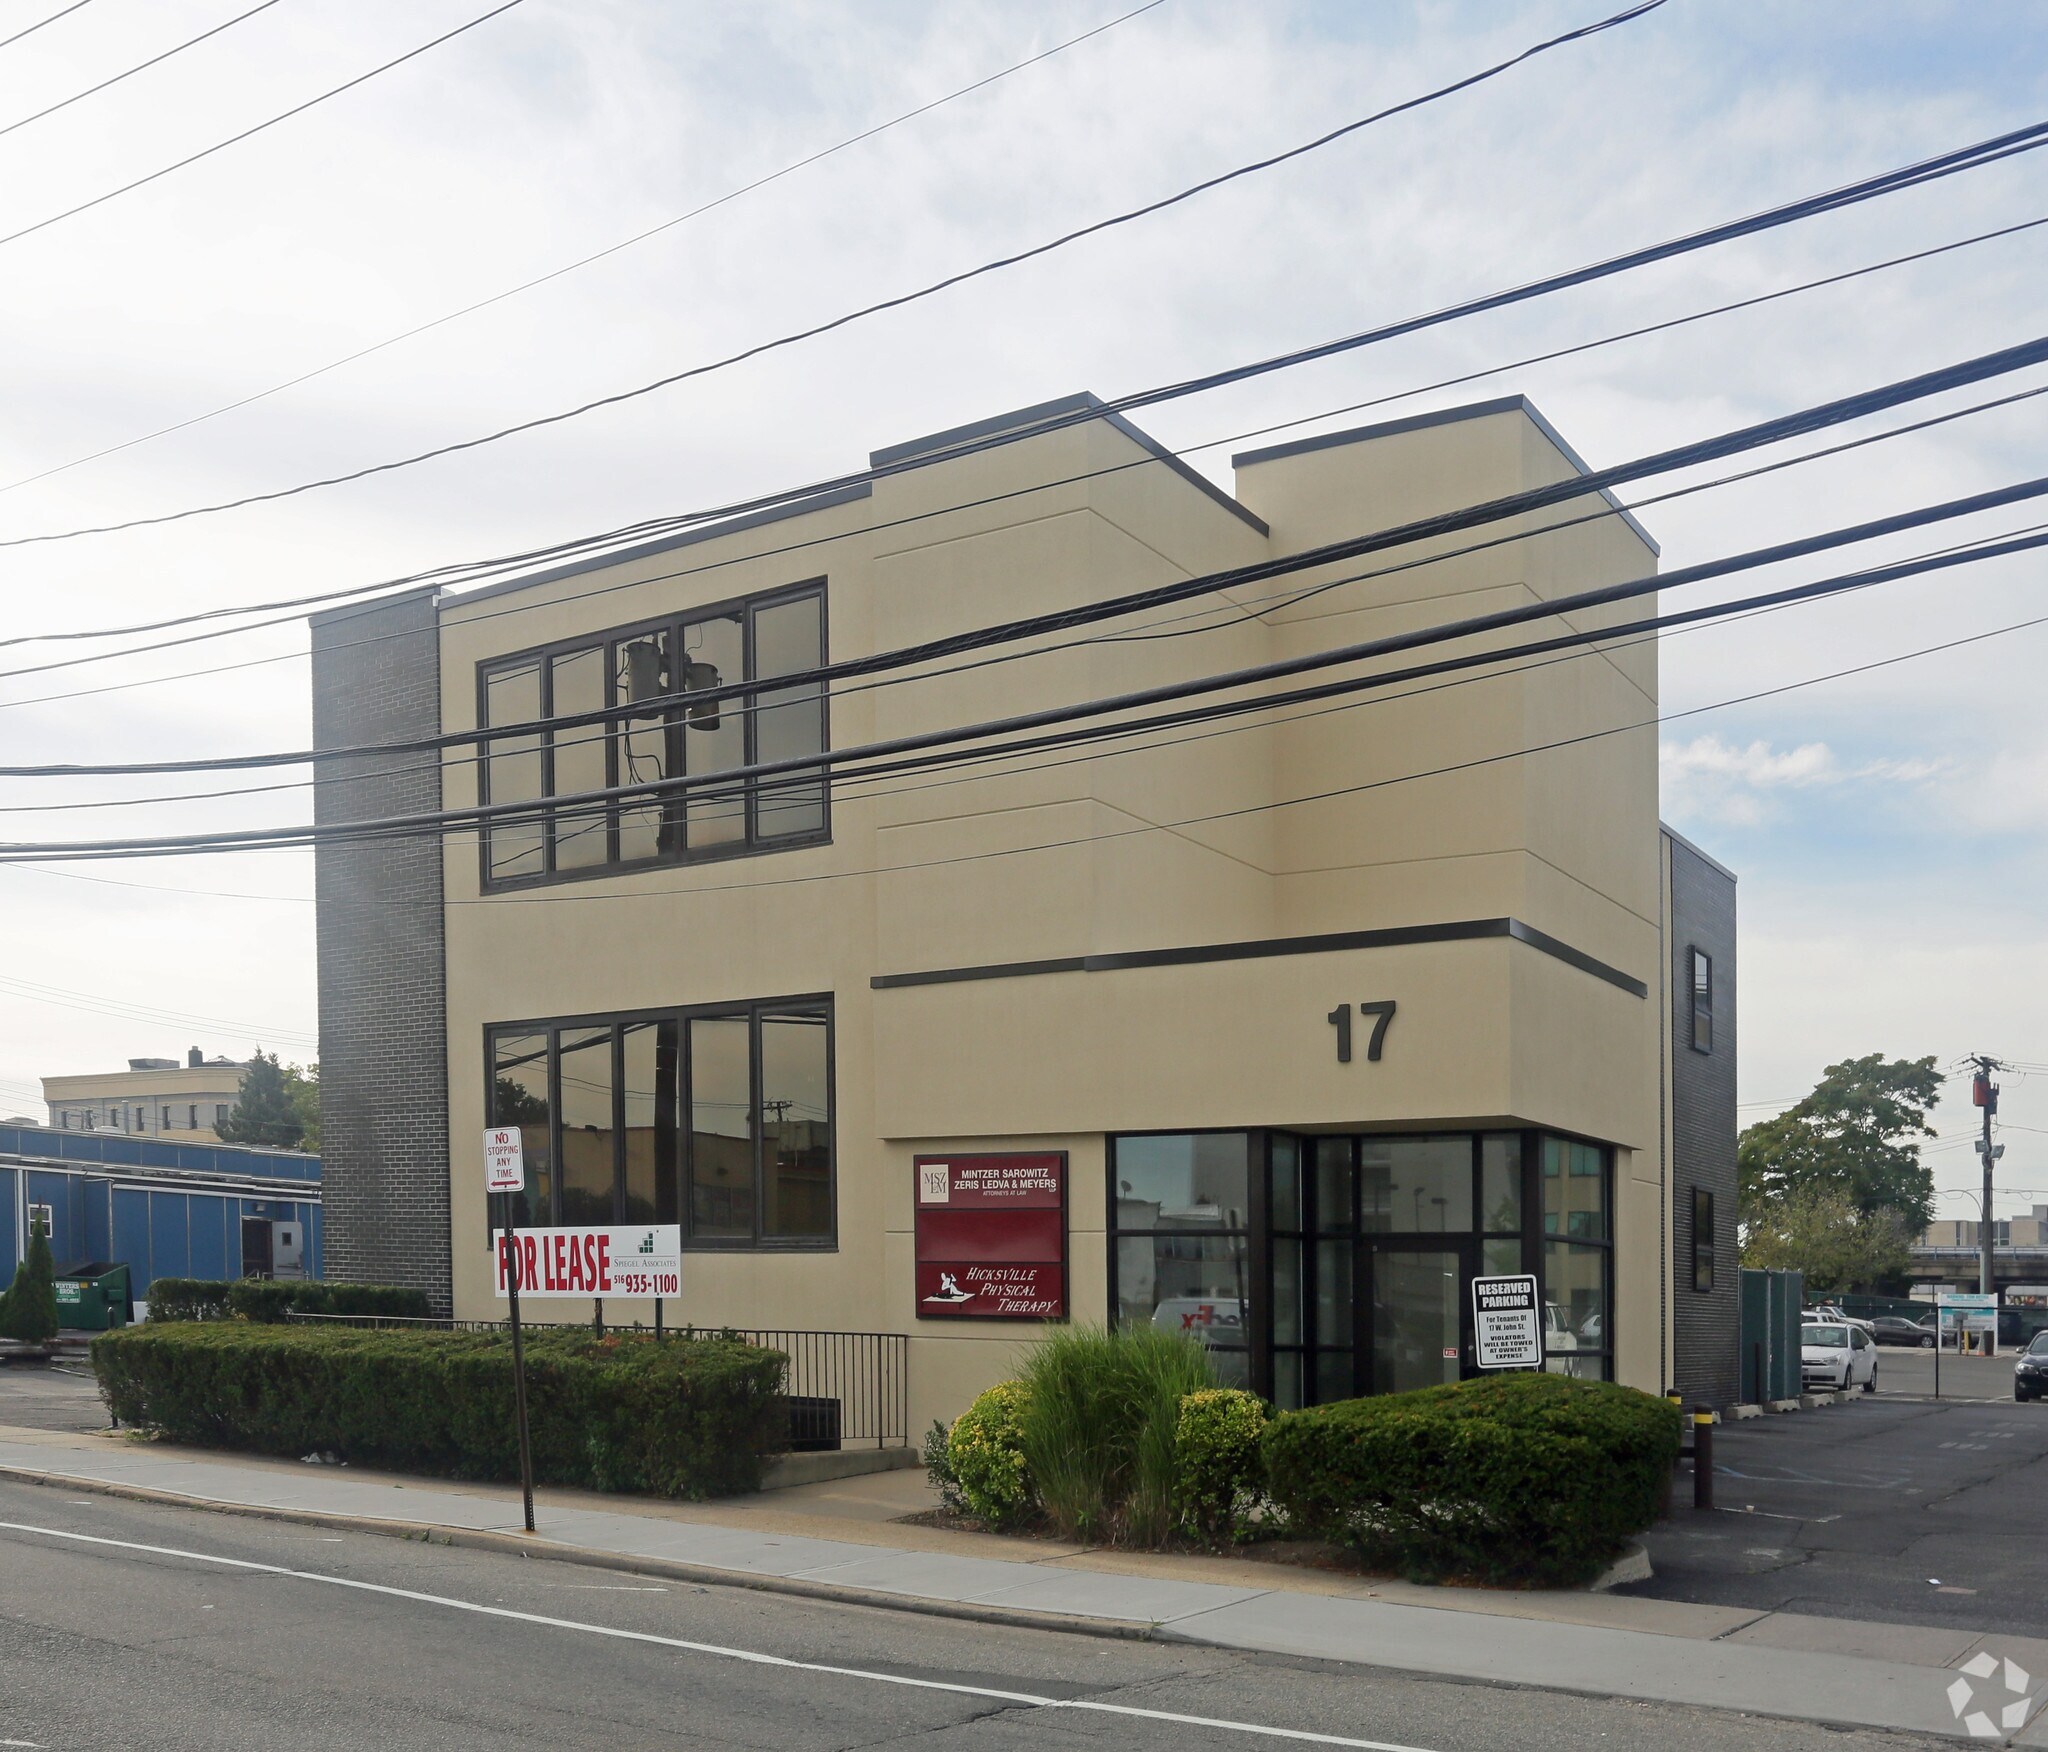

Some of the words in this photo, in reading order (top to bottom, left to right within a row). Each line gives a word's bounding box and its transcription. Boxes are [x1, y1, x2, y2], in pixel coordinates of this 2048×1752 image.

[1328, 1000, 1396, 1062] 17
[495, 1133, 509, 1144] NO
[487, 1145, 519, 1156] STOPPING
[496, 1158, 511, 1166] ANY
[496, 1169, 513, 1178] TIME
[961, 1170, 1000, 1179] MINTZER
[1002, 1168, 1049, 1178] SAROWITZ
[954, 1180, 980, 1190] ZERIS
[982, 1180, 1011, 1189] LEDVA
[1012, 1180, 1018, 1189] &
[1020, 1179, 1057, 1189] MEYERS
[543, 1234, 612, 1292] LEASE
[614, 1259, 639, 1268] SPIEGEL
[642, 1259, 676, 1267] ASSOCIATES
[966, 1267, 1037, 1281] HICKSVILLE
[614, 1275, 624, 1284] 516
[626, 1274, 678, 1293] 935-1100
[979, 1283, 1036, 1296] PHYSICAL
[1478, 1283, 1531, 1295] RESERVED
[997, 1298, 1058, 1313] THERAPY
[1483, 1295, 1528, 1307] PARKING
